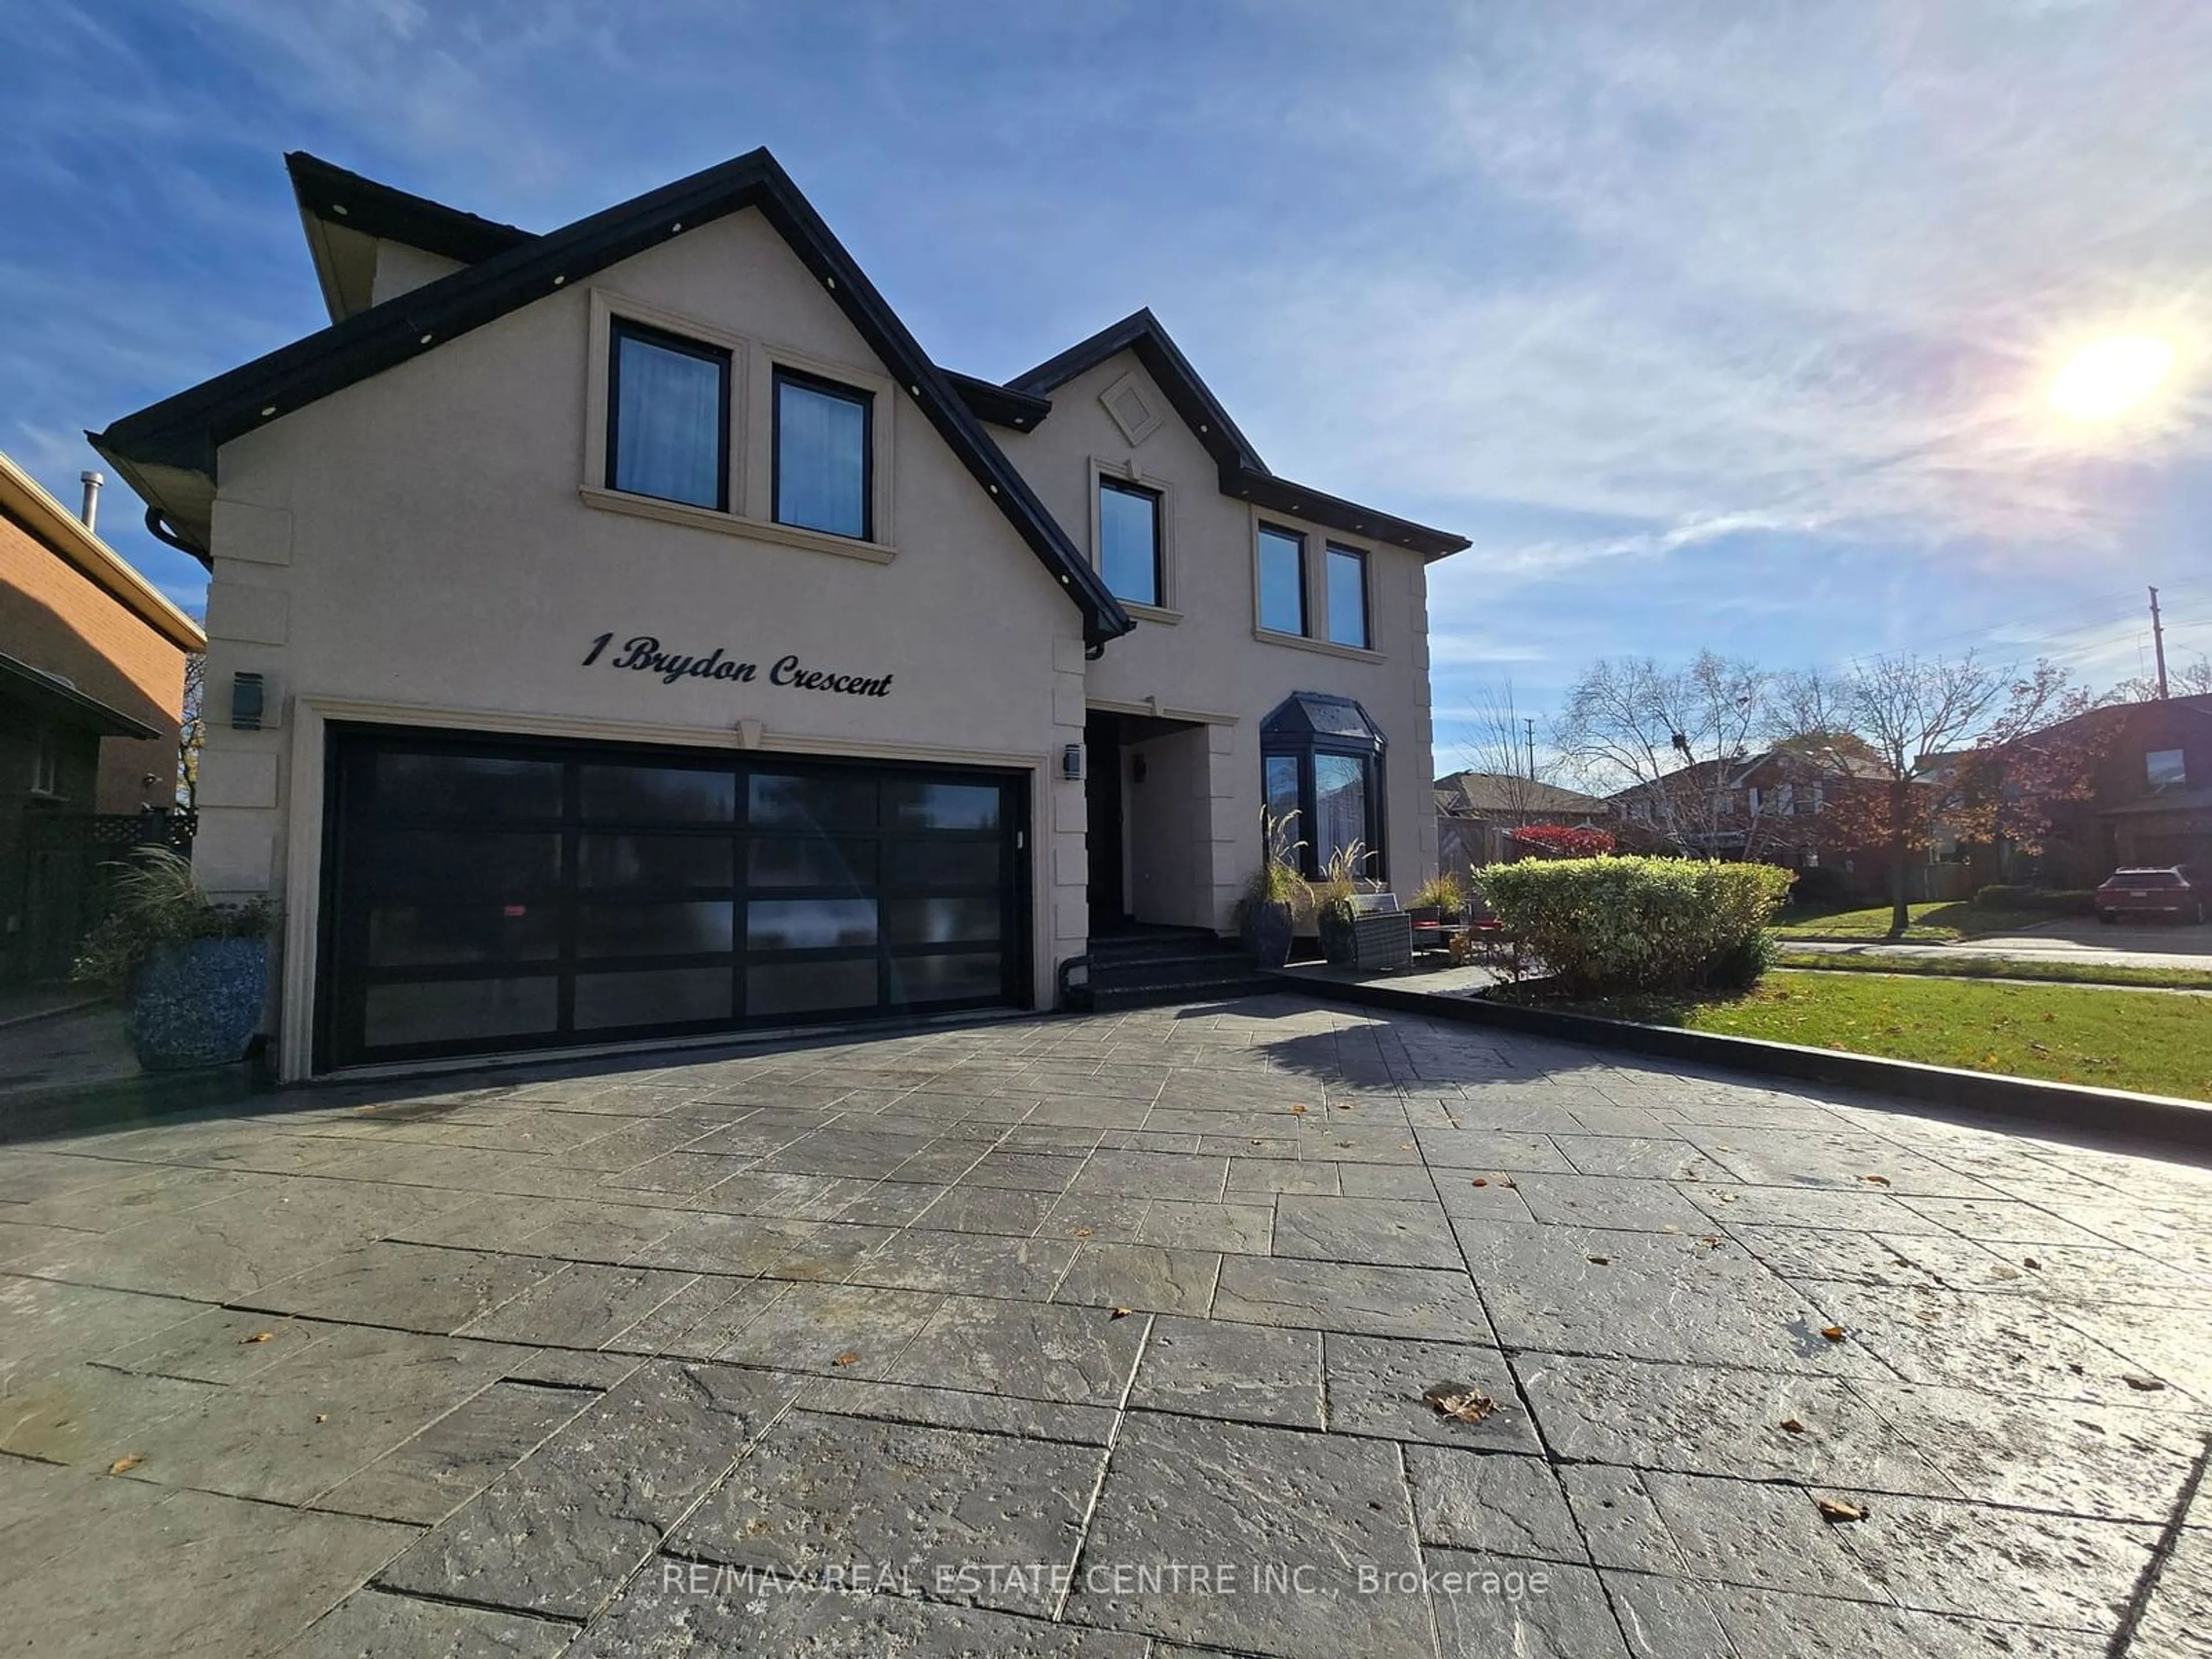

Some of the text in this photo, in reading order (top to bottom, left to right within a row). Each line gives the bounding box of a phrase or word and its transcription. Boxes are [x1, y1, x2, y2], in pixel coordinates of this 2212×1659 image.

[582, 632, 894, 698] 1 Brydon Crescent
